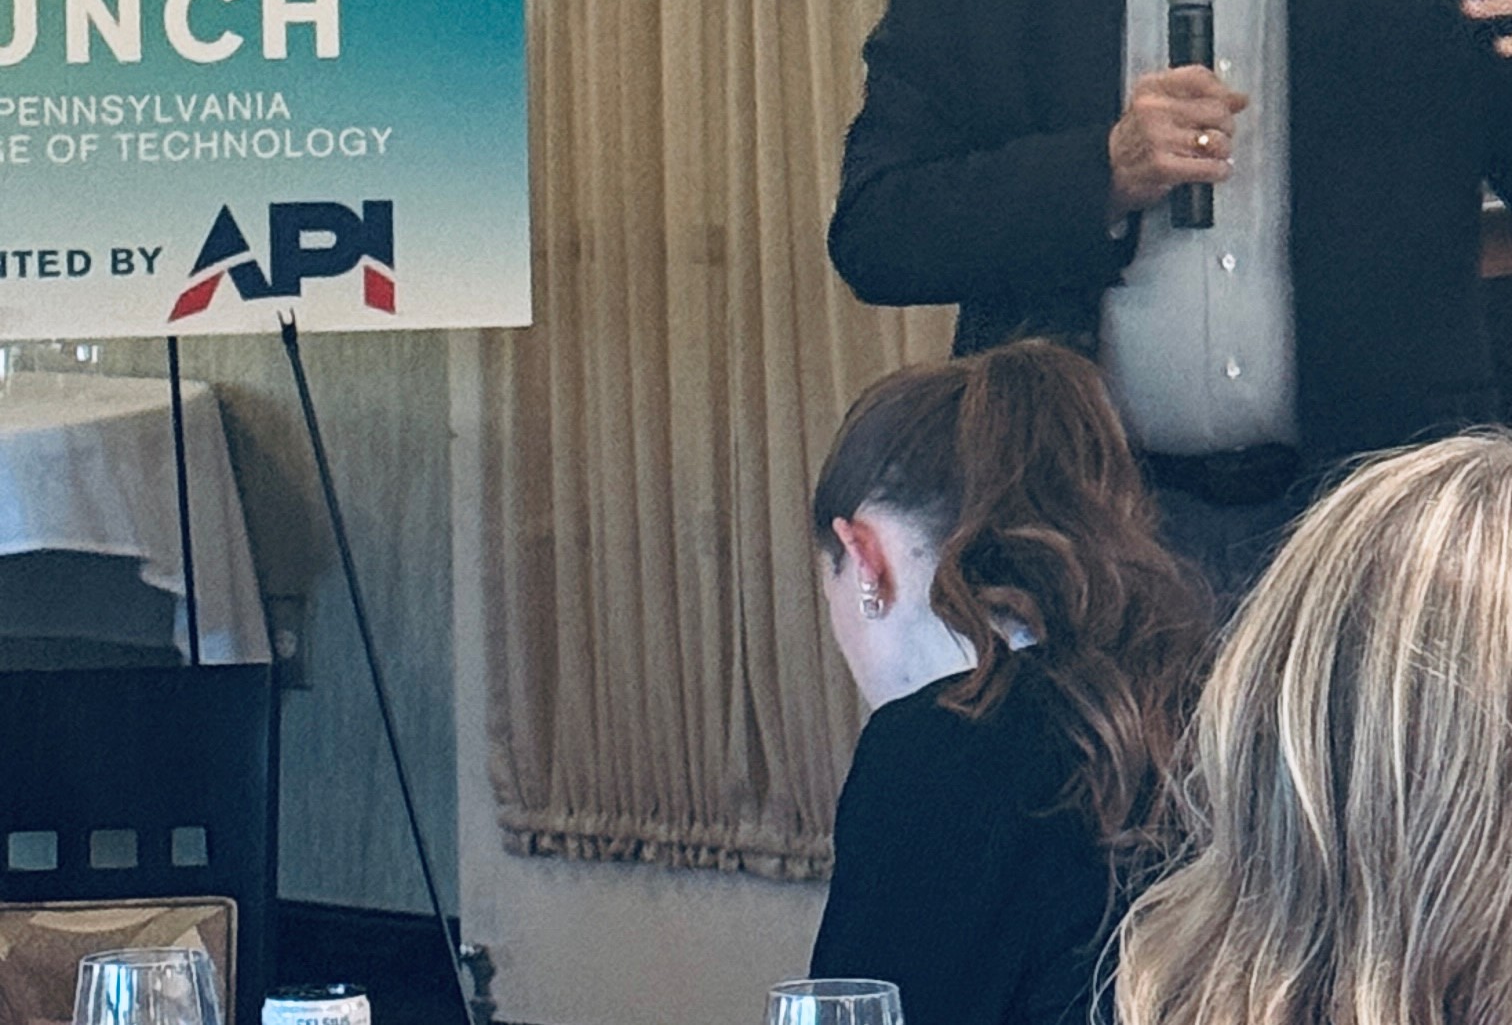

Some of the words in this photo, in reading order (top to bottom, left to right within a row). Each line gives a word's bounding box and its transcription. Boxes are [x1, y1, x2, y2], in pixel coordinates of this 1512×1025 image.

[47, 134, 99, 163] OF
[116, 127, 392, 161] TECHNOLOGY
[111, 247, 162, 275] BY
[169, 199, 395, 325] API
